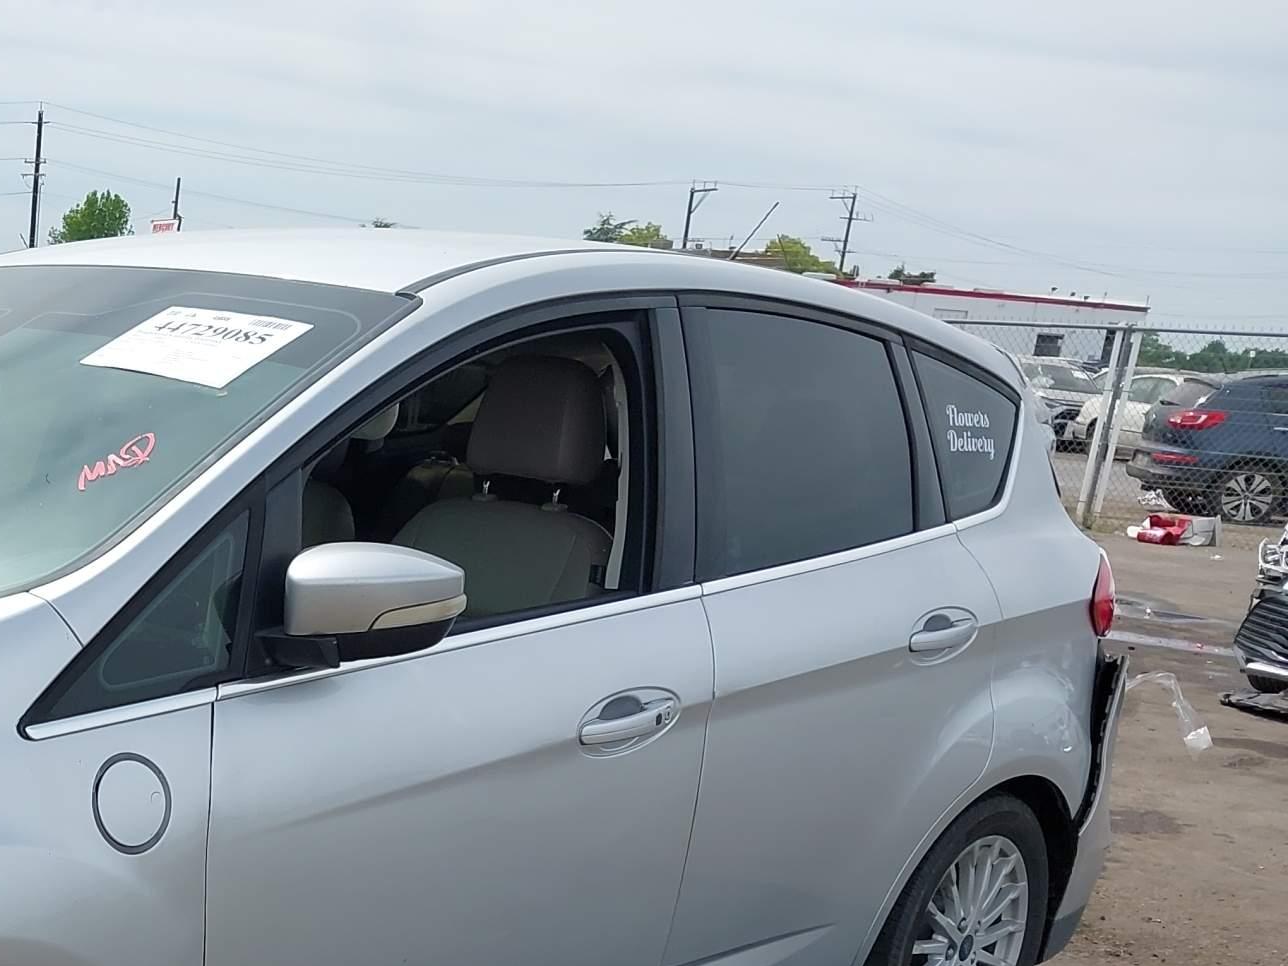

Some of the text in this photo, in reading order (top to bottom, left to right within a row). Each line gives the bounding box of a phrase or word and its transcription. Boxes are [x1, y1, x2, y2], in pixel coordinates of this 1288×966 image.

[154, 320, 274, 345] 44729085
[945, 404, 990, 428] Flowers
[946, 429, 995, 460] Delivery
